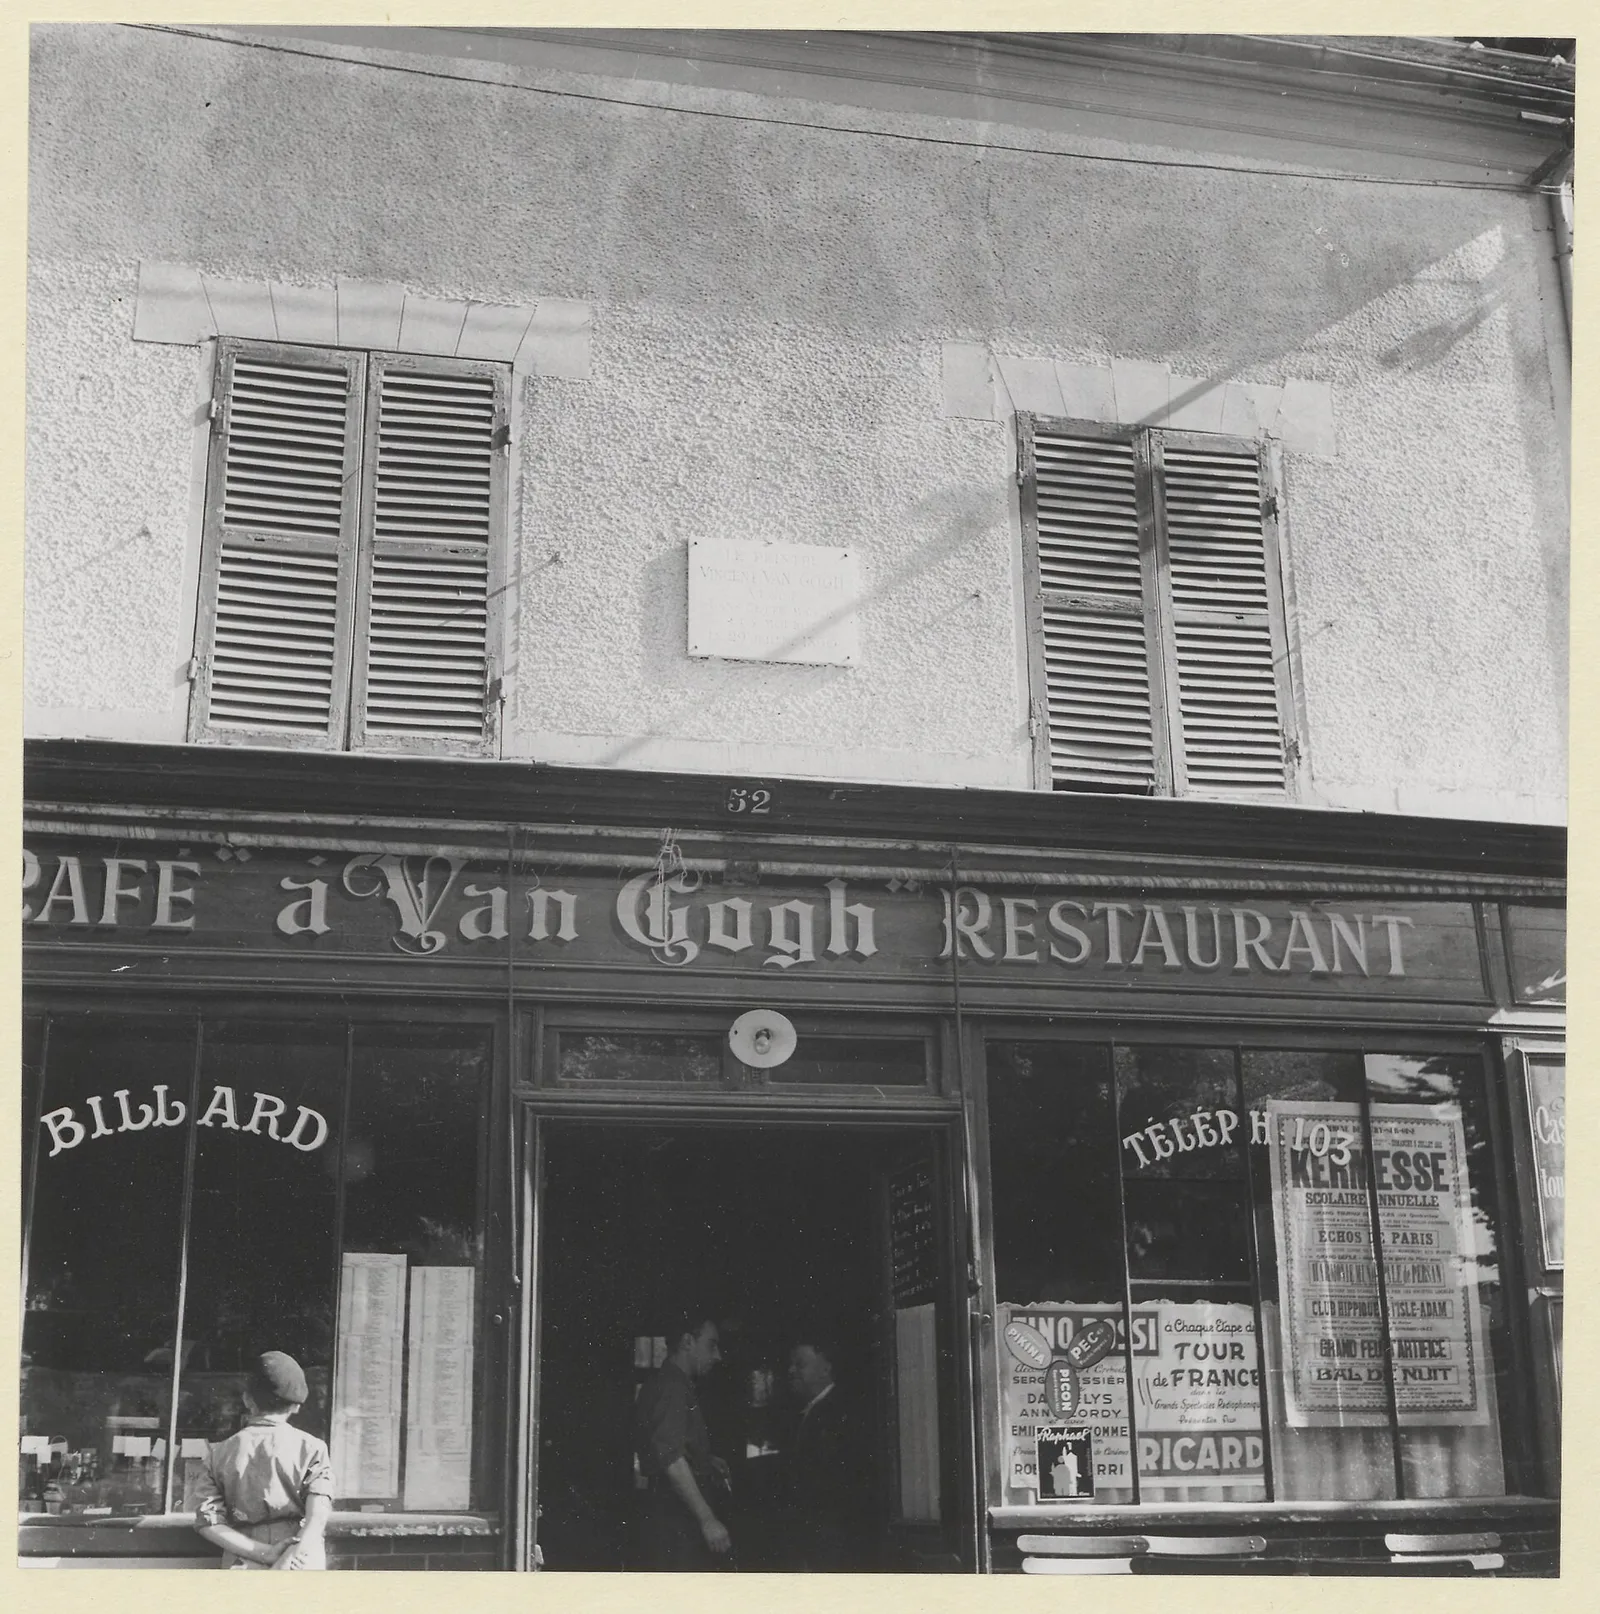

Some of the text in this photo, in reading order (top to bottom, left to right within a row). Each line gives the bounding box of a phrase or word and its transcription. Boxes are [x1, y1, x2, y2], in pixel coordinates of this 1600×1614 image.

[761, 569, 791, 586] VAN
[728, 789, 771, 813] 52
[343, 853, 579, 956] Van
[616, 869, 878, 969] Gogh
[940, 885, 1414, 979] RESTAURANT
[40, 1084, 329, 1158] BILLARD
[1292, 1117, 1355, 1166] 103
[1290, 1149, 1450, 1192] KERMESSE
[1305, 1193, 1440, 1207] SCOLAIRE NNUELLE
[1391, 1231, 1434, 1245] PARIS
[1312, 1301, 1336, 1315] CLUB
[1174, 1319, 1214, 1337] Chaque
[1008, 1327, 1046, 1365] PIKINA
[1174, 1342, 1246, 1361] TOUR
[1320, 1339, 1357, 1357] GRAND
[1153, 1372, 1169, 1387] de
[1317, 1368, 1362, 1381] BAL
[1402, 1368, 1452, 1382] NUIT
[1060, 1369, 1072, 1411] PICON
[1139, 1436, 1264, 1471] RICARD
